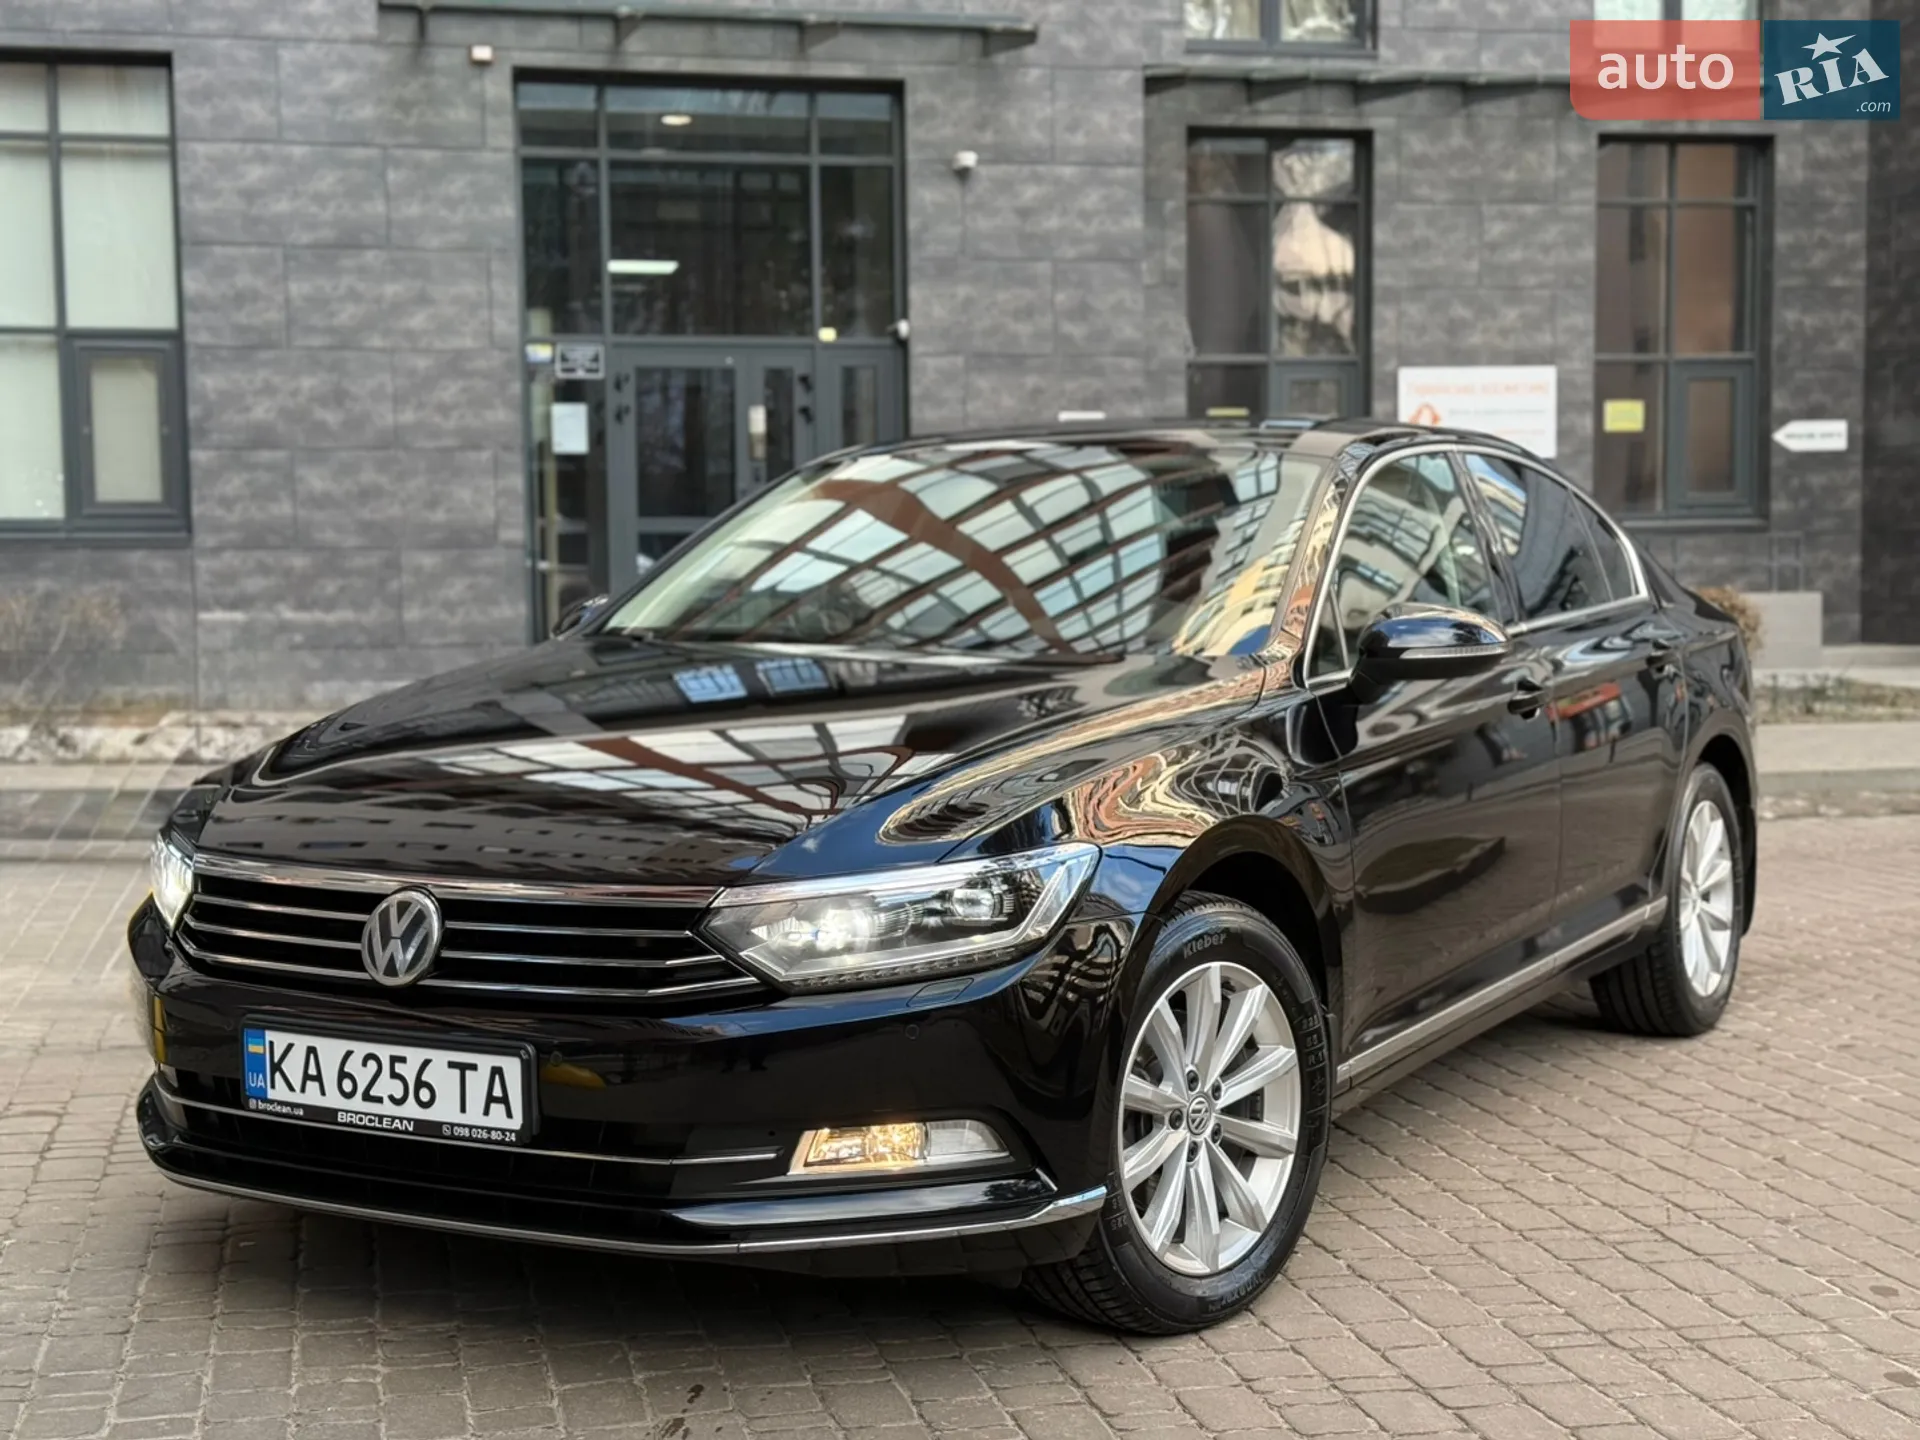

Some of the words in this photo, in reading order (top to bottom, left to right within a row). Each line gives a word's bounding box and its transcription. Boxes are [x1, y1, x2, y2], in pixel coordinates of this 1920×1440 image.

[1183, 933, 1228, 960] Kleber
[248, 1072, 266, 1089] UA
[268, 1040, 327, 1097] KA
[337, 1049, 437, 1110] 6256
[447, 1060, 514, 1120] TA
[257, 1099, 304, 1116] broclean.ua
[337, 1111, 415, 1131] BROCLEAN
[453, 1126, 471, 1138] 098
[471, 1127, 516, 1142] 026-80-24
